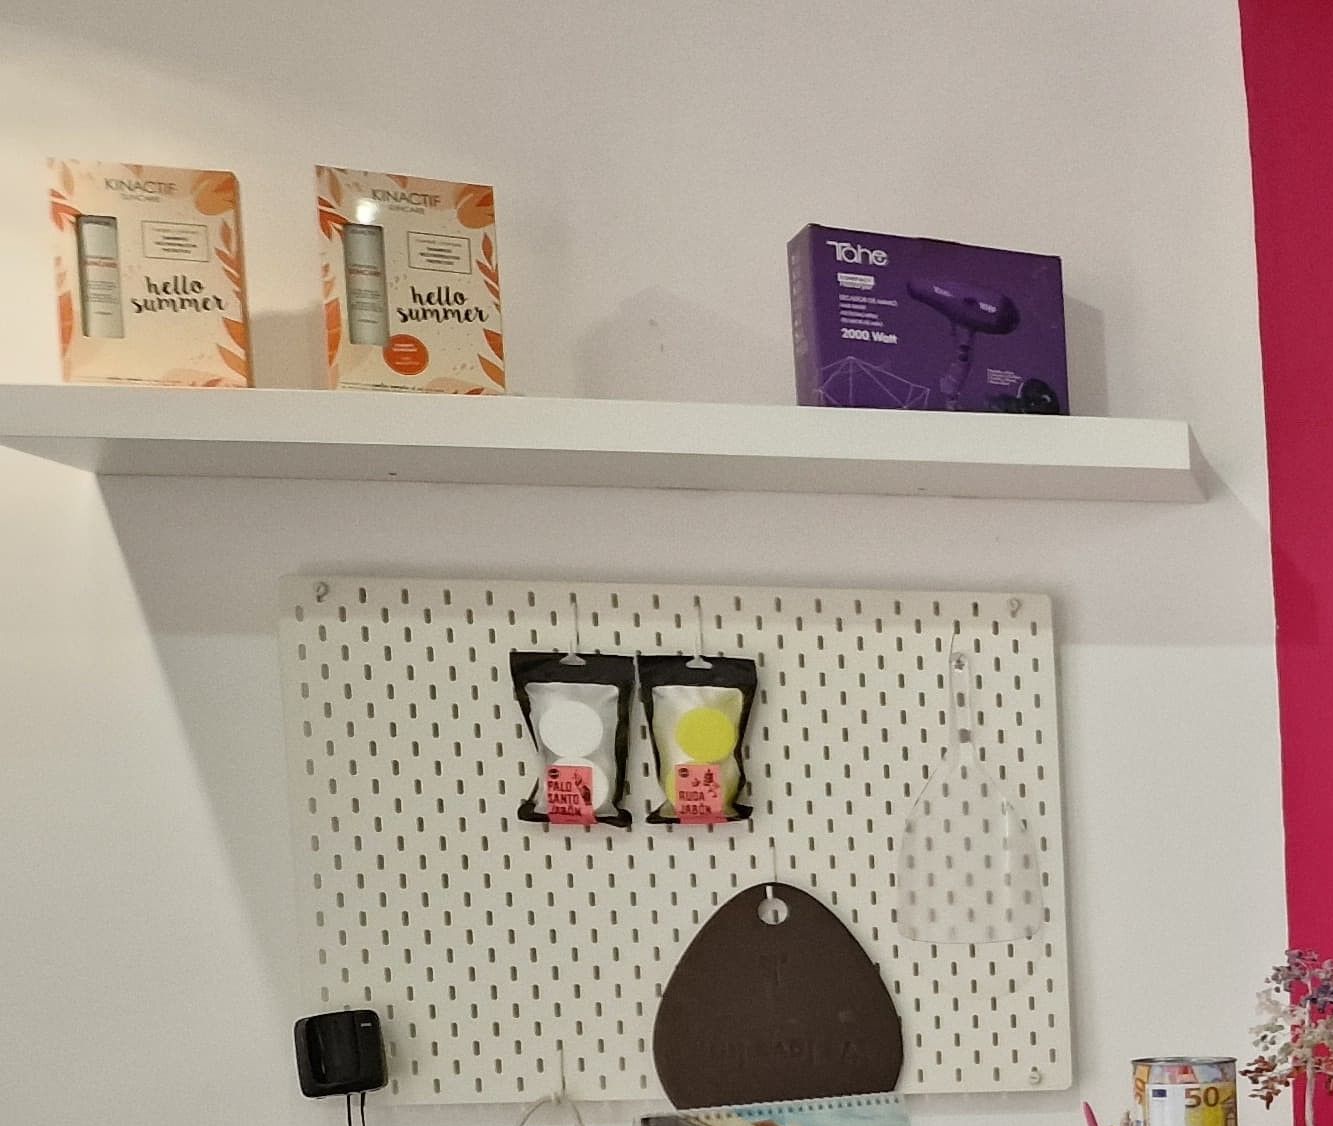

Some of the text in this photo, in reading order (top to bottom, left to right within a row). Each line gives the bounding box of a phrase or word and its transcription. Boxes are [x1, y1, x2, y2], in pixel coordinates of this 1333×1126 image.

[104, 178, 177, 194] KINACTIF
[371, 188, 441, 208] KINACTIF
[826, 240, 889, 266] Tahe
[143, 275, 205, 295] hello
[130, 294, 225, 314] summer
[410, 286, 469, 306] hello
[397, 305, 490, 324] summer
[841, 327, 898, 345] 2000 Watt
[547, 781, 572, 792] PALO
[547, 793, 580, 805] SANTO
[1184, 1086, 1220, 1109] 50
